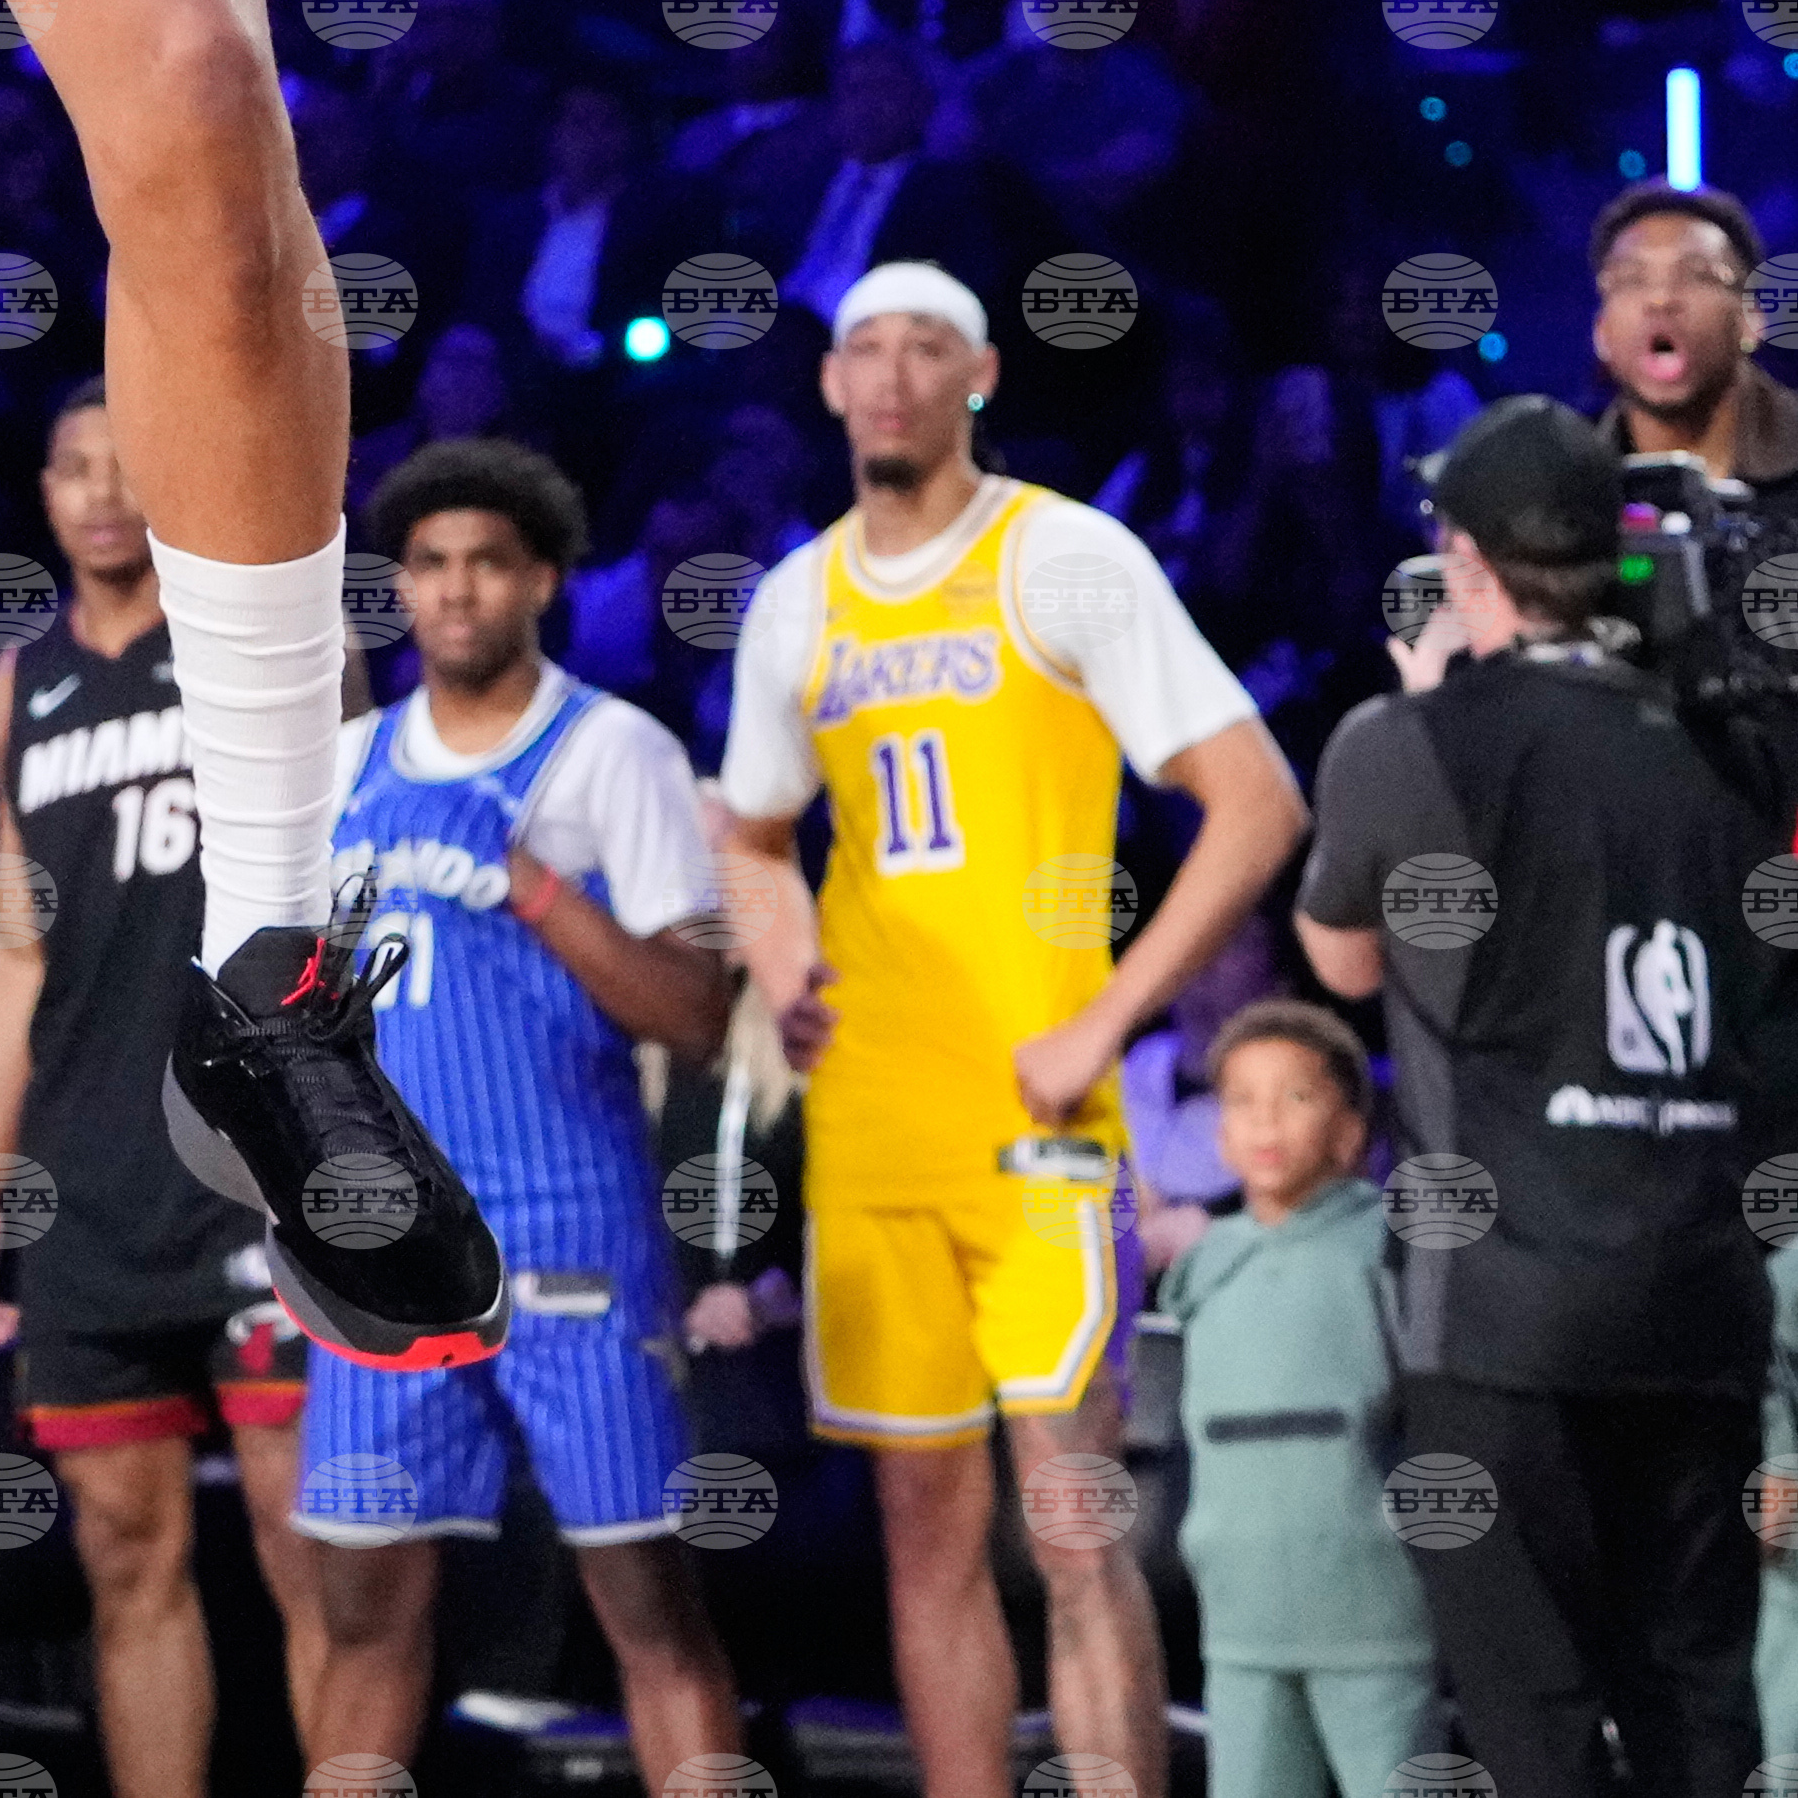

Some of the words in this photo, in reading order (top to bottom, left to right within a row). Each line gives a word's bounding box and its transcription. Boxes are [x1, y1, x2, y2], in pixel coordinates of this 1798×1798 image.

[814, 626, 1003, 729] LAKERS
[112, 776, 199, 883] 16
[871, 728, 966, 877] 11
